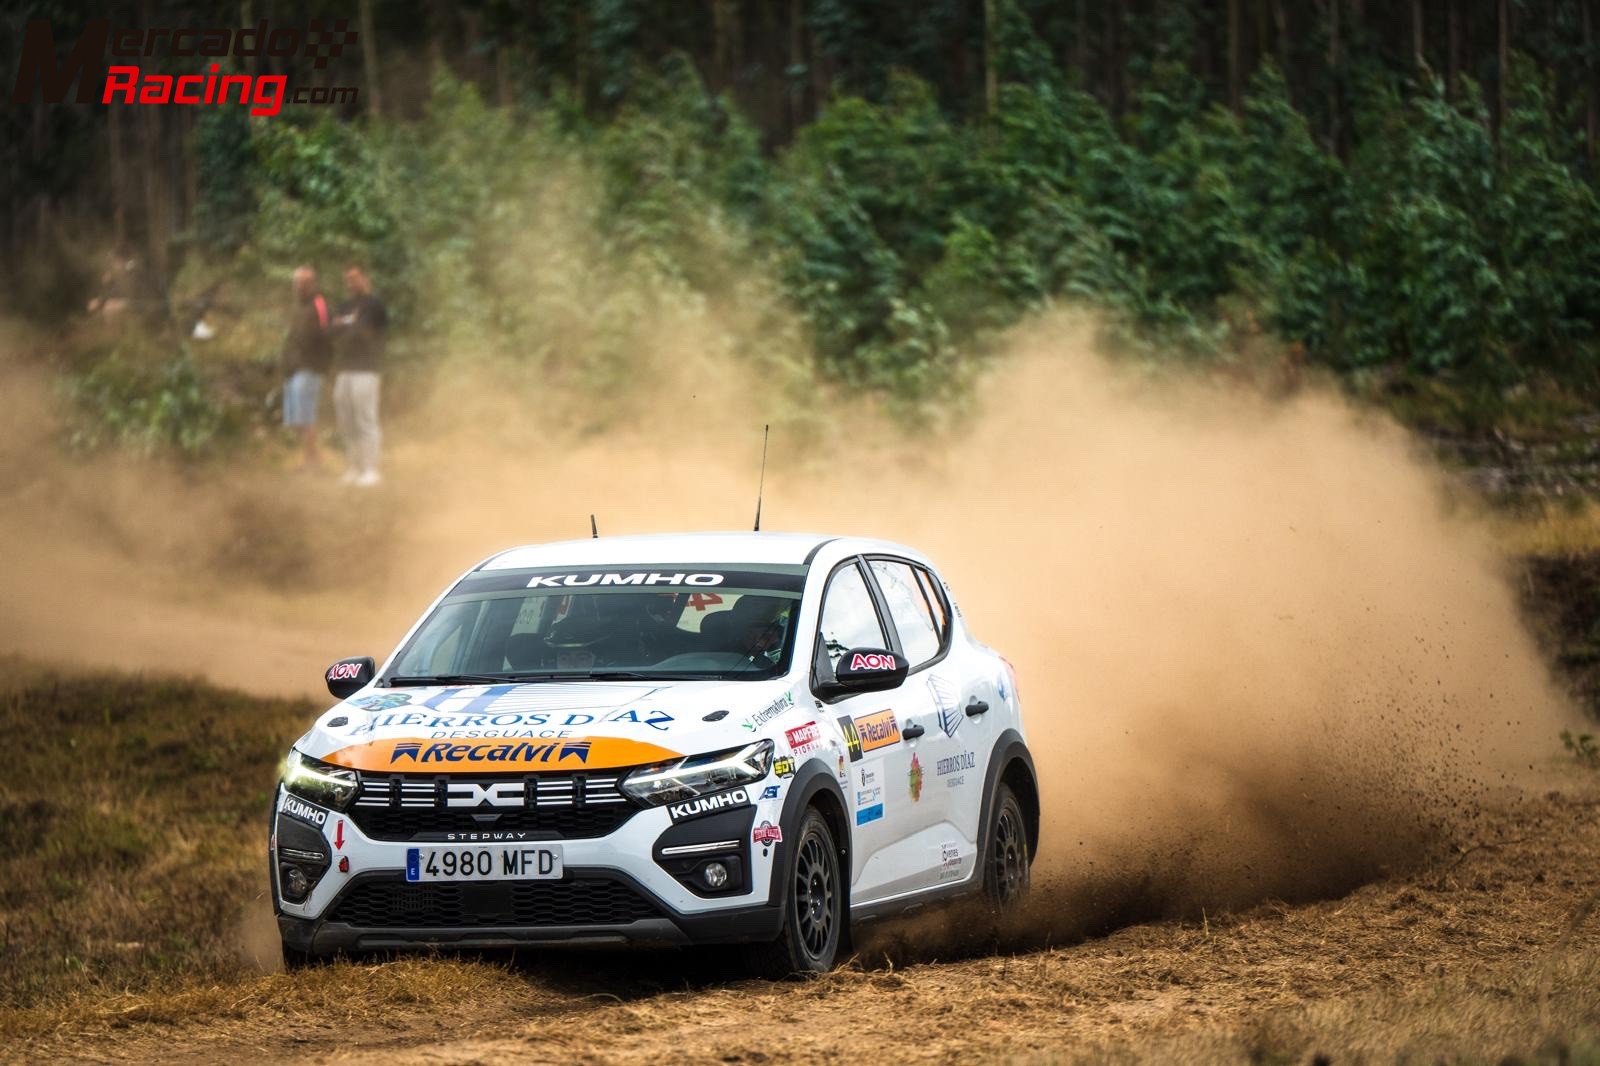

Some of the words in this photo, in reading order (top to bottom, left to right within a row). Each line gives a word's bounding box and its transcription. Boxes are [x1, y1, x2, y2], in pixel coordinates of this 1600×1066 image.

[526, 573, 724, 588] KUMHO
[327, 664, 362, 680] AON
[851, 653, 896, 670] AON
[344, 711, 551, 737] HIERROS
[431, 729, 573, 738] DESGUACE
[866, 718, 892, 743] Recalvi
[843, 723, 860, 753] 44
[421, 742, 560, 763] Recalvi
[937, 755, 960, 777] HIERROS
[284, 797, 327, 825] KUMHO
[670, 790, 748, 819] KUMHO
[447, 832, 526, 840] STEPWAY
[410, 867, 416, 876] E
[425, 850, 493, 877] 4980
[503, 850, 554, 876] MFD
